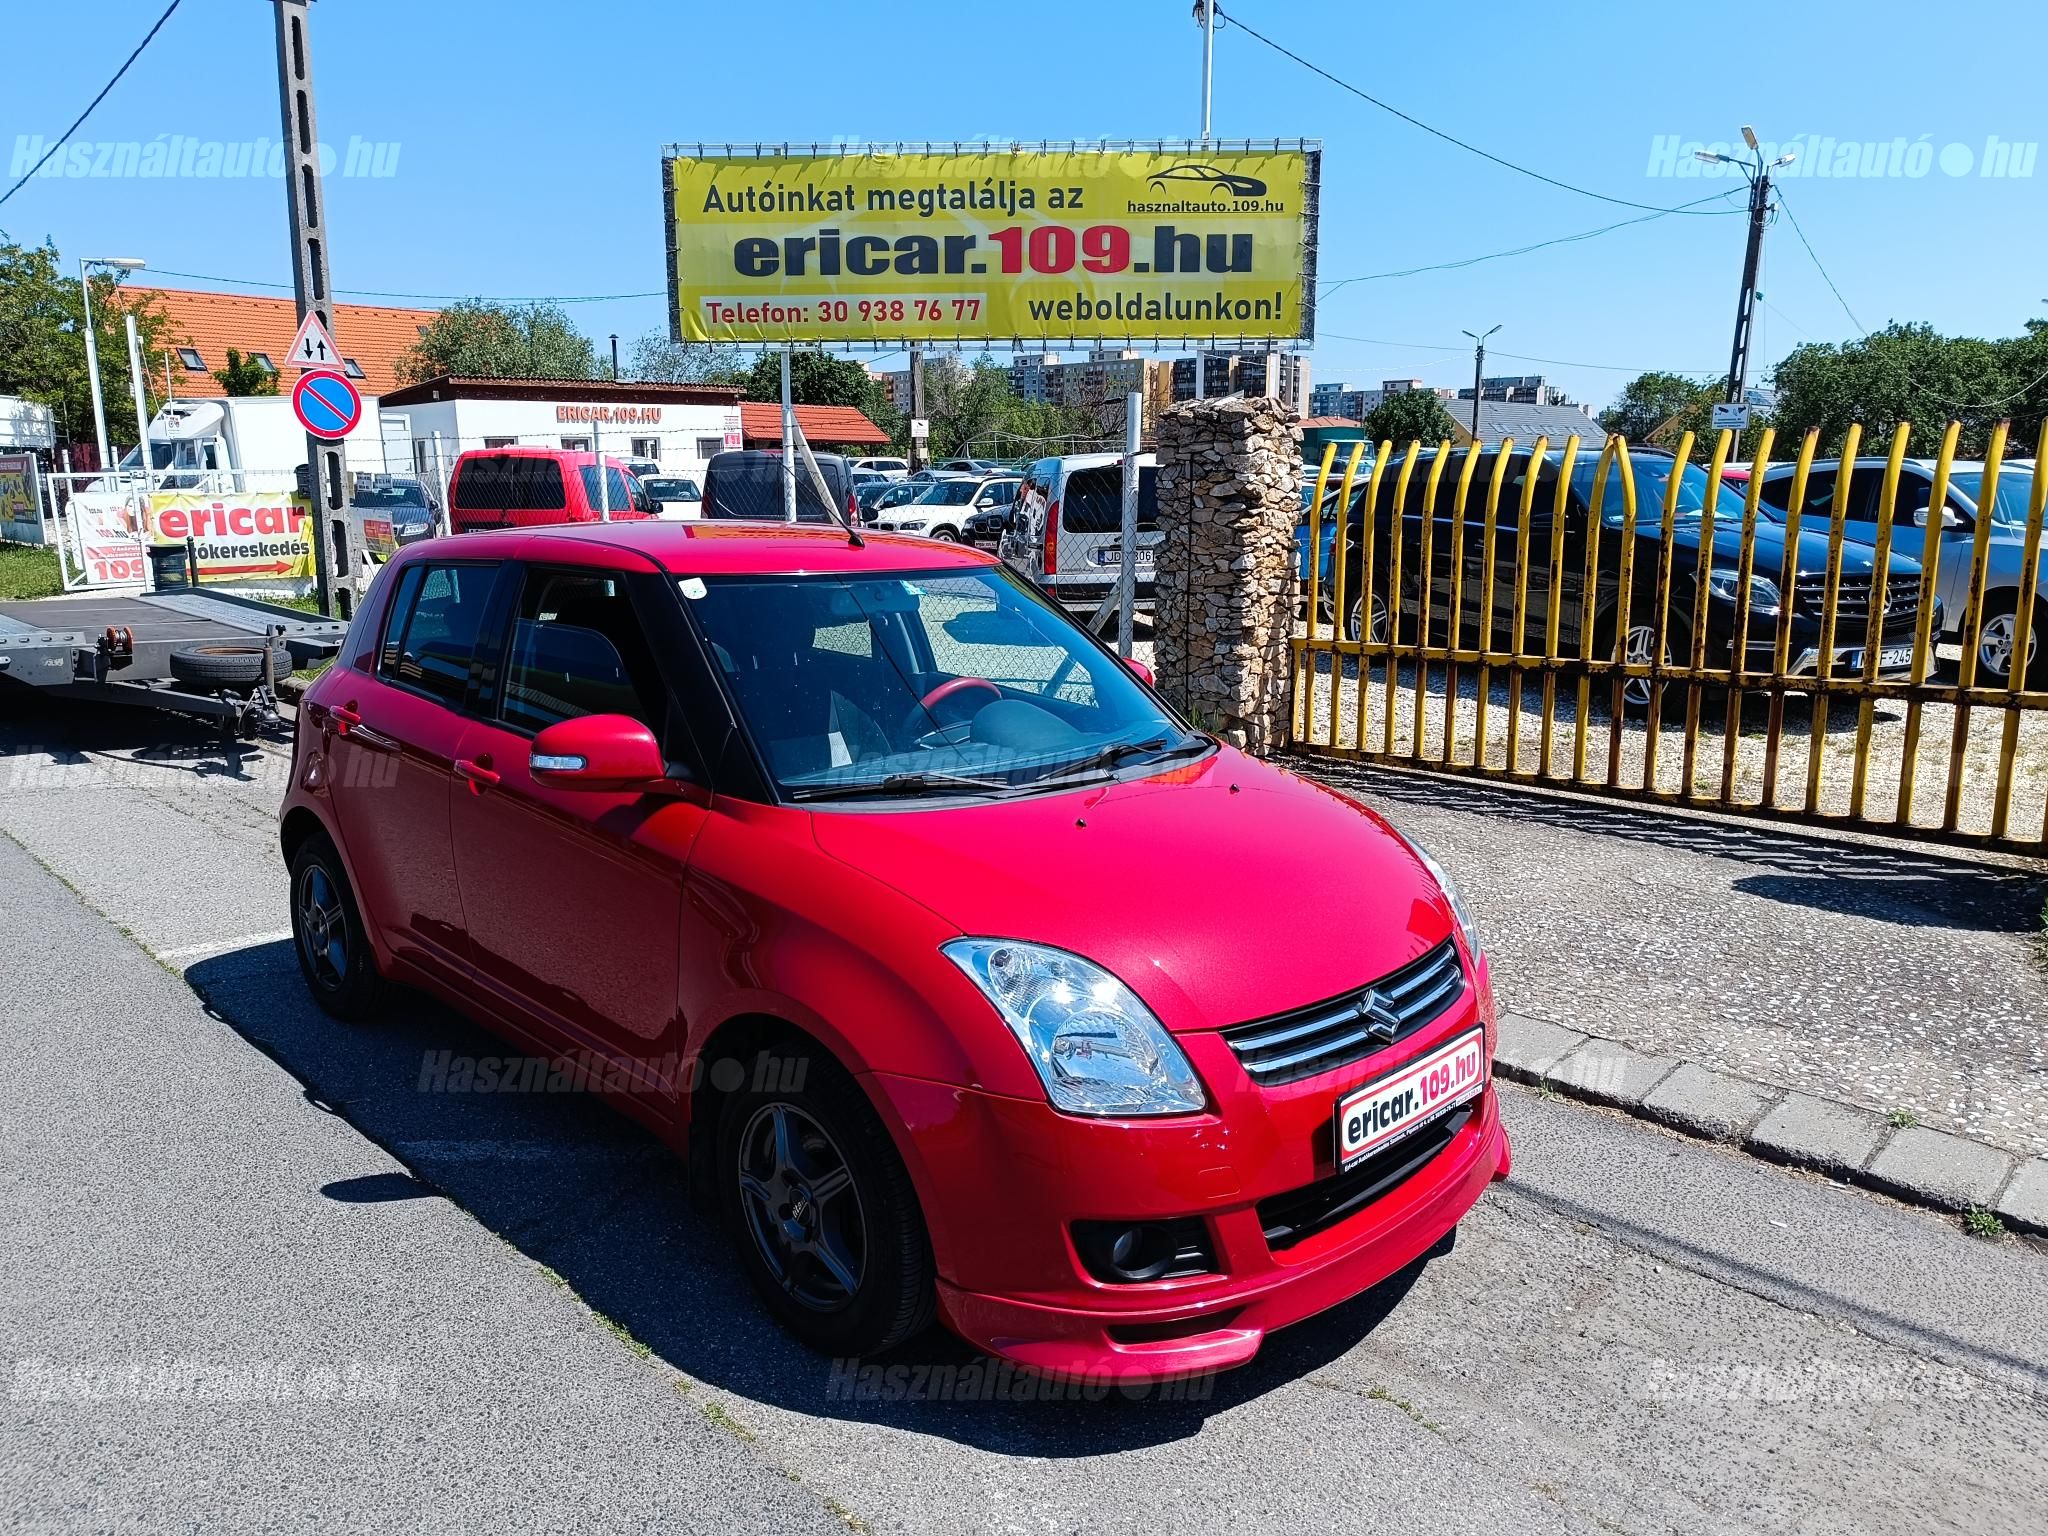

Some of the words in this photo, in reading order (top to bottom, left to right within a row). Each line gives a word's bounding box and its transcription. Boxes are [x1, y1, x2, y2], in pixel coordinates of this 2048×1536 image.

[703, 180, 854, 212] Autóinkat
[868, 177, 1035, 217] megtalálja
[1048, 188, 1083, 208] az
[1127, 200, 1284, 213] hasznaltauto.109.hu
[734, 225, 1253, 276] ericar.109.hu
[706, 302, 809, 323] Telefon:
[818, 301, 848, 322] 30
[858, 300, 904, 321] 938
[914, 300, 942, 321] 76
[952, 300, 980, 321] 77
[1028, 292, 1281, 321] weboldalunkon!
[556, 406, 661, 424] ERICAR.109.HU
[159, 503, 305, 538] ericar
[1348, 1049, 1475, 1145] ericar.109.hu
